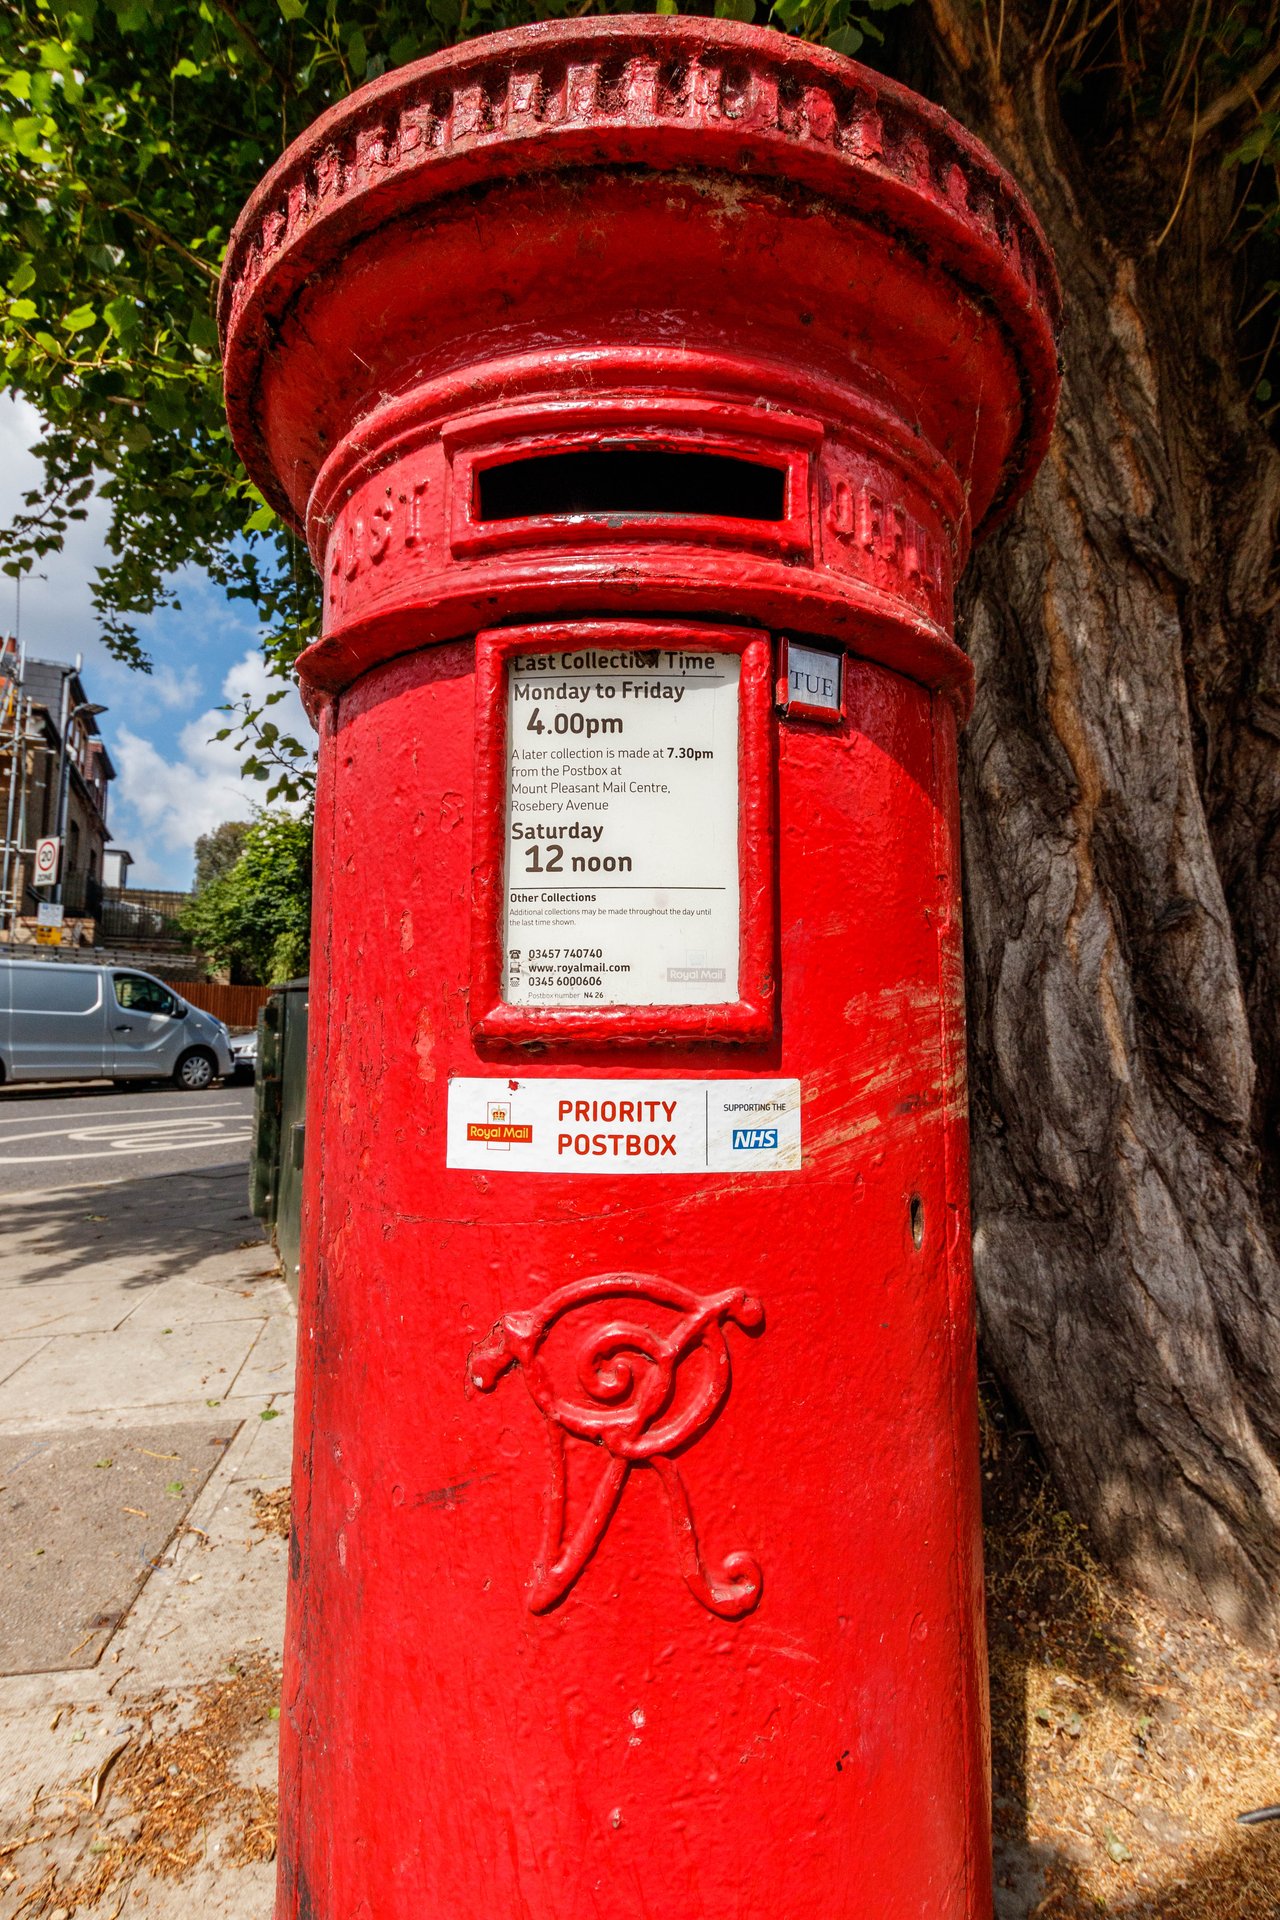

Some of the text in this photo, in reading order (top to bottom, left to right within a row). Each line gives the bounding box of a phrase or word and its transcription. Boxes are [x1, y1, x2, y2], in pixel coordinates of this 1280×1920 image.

[514, 654, 556, 672] Last
[664, 651, 715, 669] Time
[790, 669, 834, 698] TUE
[514, 680, 686, 703] Monday to Friday
[527, 707, 624, 738] 4.00pm
[511, 747, 714, 761] A later collection is made at 7.30pm
[511, 765, 622, 777] from the Postbox at
[511, 783, 548, 794] Mount
[551, 782, 600, 794] Pleasant
[602, 781, 626, 793] Mail
[511, 799, 609, 813] Rosebery Avenue
[511, 822, 604, 842] Saturday
[41, 850, 53, 862] 20
[525, 844, 633, 873] 12 noon
[510, 892, 597, 903] Other Collections
[509, 908, 544, 916] Additional
[581, 909, 596, 917] may
[598, 907, 607, 915] be
[629, 908, 668, 916] throughout
[682, 908, 695, 917] day
[528, 948, 603, 959] 03457 740740
[528, 962, 631, 974] www.royalmail.com
[670, 969, 723, 981] Royal Mail
[528, 976, 602, 986] 0345 6000606
[528, 991, 553, 999] Postbox
[558, 1100, 678, 1122] PRIORITY
[723, 1103, 786, 1112] SUPPORTING THE
[470, 1125, 529, 1140] Royal Mail
[734, 1130, 777, 1148] NHS
[558, 1134, 678, 1156] POSTBOX
